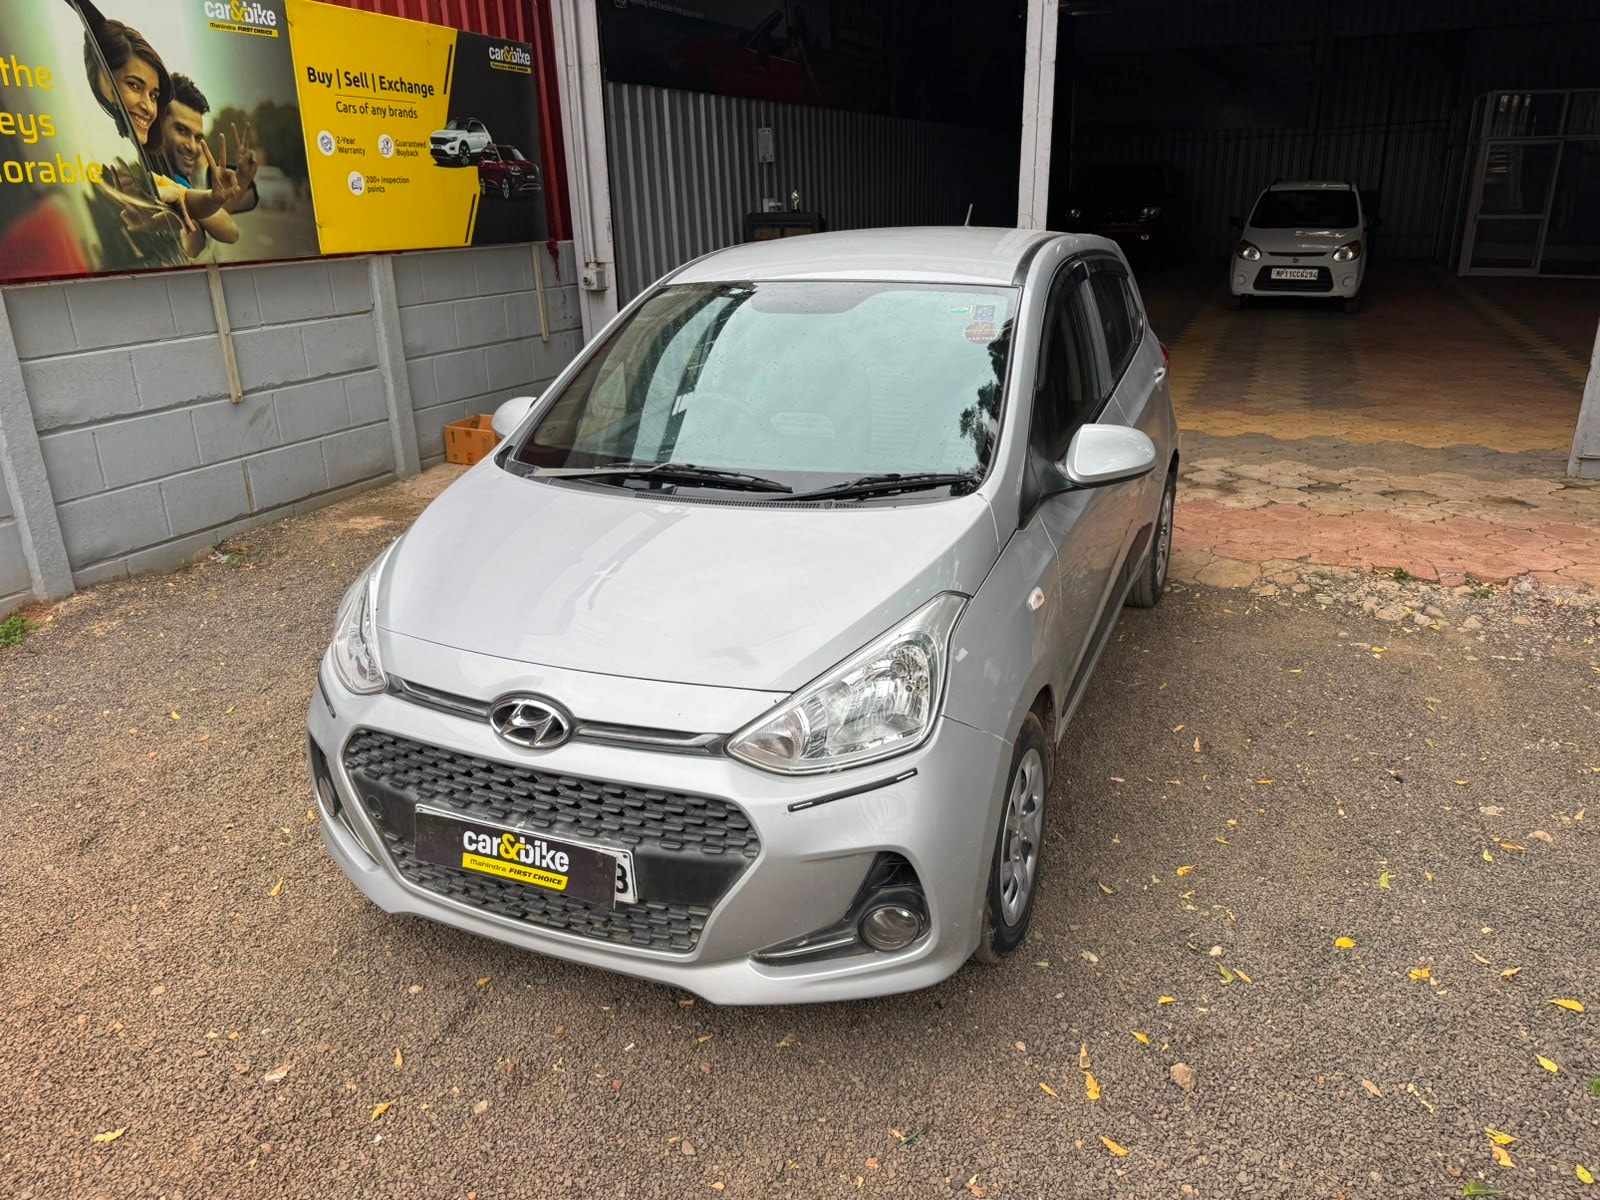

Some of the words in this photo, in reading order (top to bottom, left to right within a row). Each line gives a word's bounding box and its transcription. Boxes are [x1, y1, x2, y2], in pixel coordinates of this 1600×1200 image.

[204, 0, 276, 26] car&bike
[489, 46, 531, 66] car&bike
[0, 55, 53, 90] the
[307, 66, 333, 88] Buy
[344, 71, 369, 89] Sell
[379, 75, 435, 98] Exchange
[336, 101, 357, 114] Cars
[359, 102, 368, 115] of
[371, 106, 387, 119] any
[388, 105, 418, 119] brands
[336, 136, 356, 145] 2-Year
[395, 139, 427, 149] Guaranteed
[337, 146, 366, 156] Warranty
[396, 149, 419, 158] Buyback
[0, 153, 104, 184] orable
[381, 176, 410, 185] inspection
[367, 186, 386, 194] points
[463, 831, 569, 873] car&bike
[509, 867, 533, 878] FIRST
[533, 873, 563, 886] CHOICE
